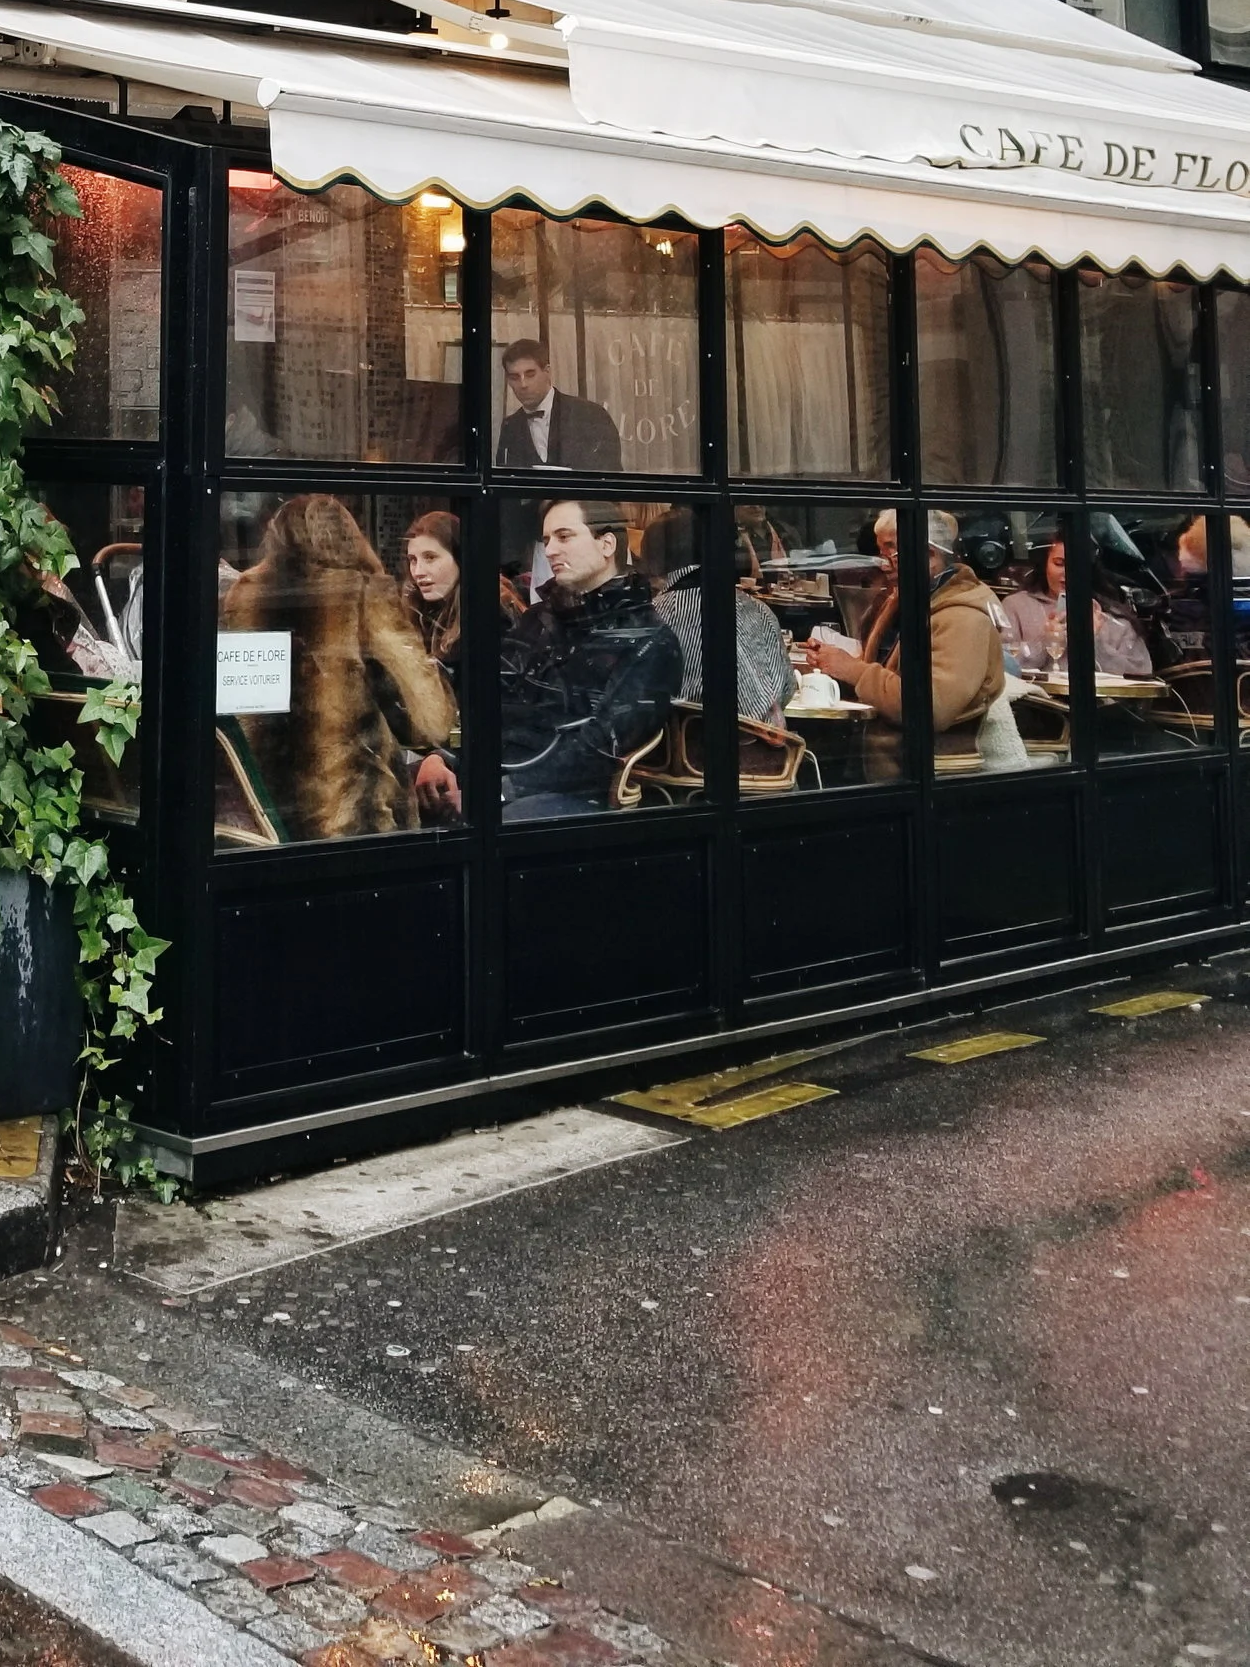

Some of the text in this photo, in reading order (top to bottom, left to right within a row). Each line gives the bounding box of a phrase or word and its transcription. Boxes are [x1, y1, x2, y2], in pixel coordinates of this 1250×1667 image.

[958, 123, 1250, 193] CAFE DE FLO
[603, 399, 696, 445] LORE
[217, 649, 286, 663] CAFE DE FLORE
[222, 674, 281, 687] SERVICE VOITURIER
